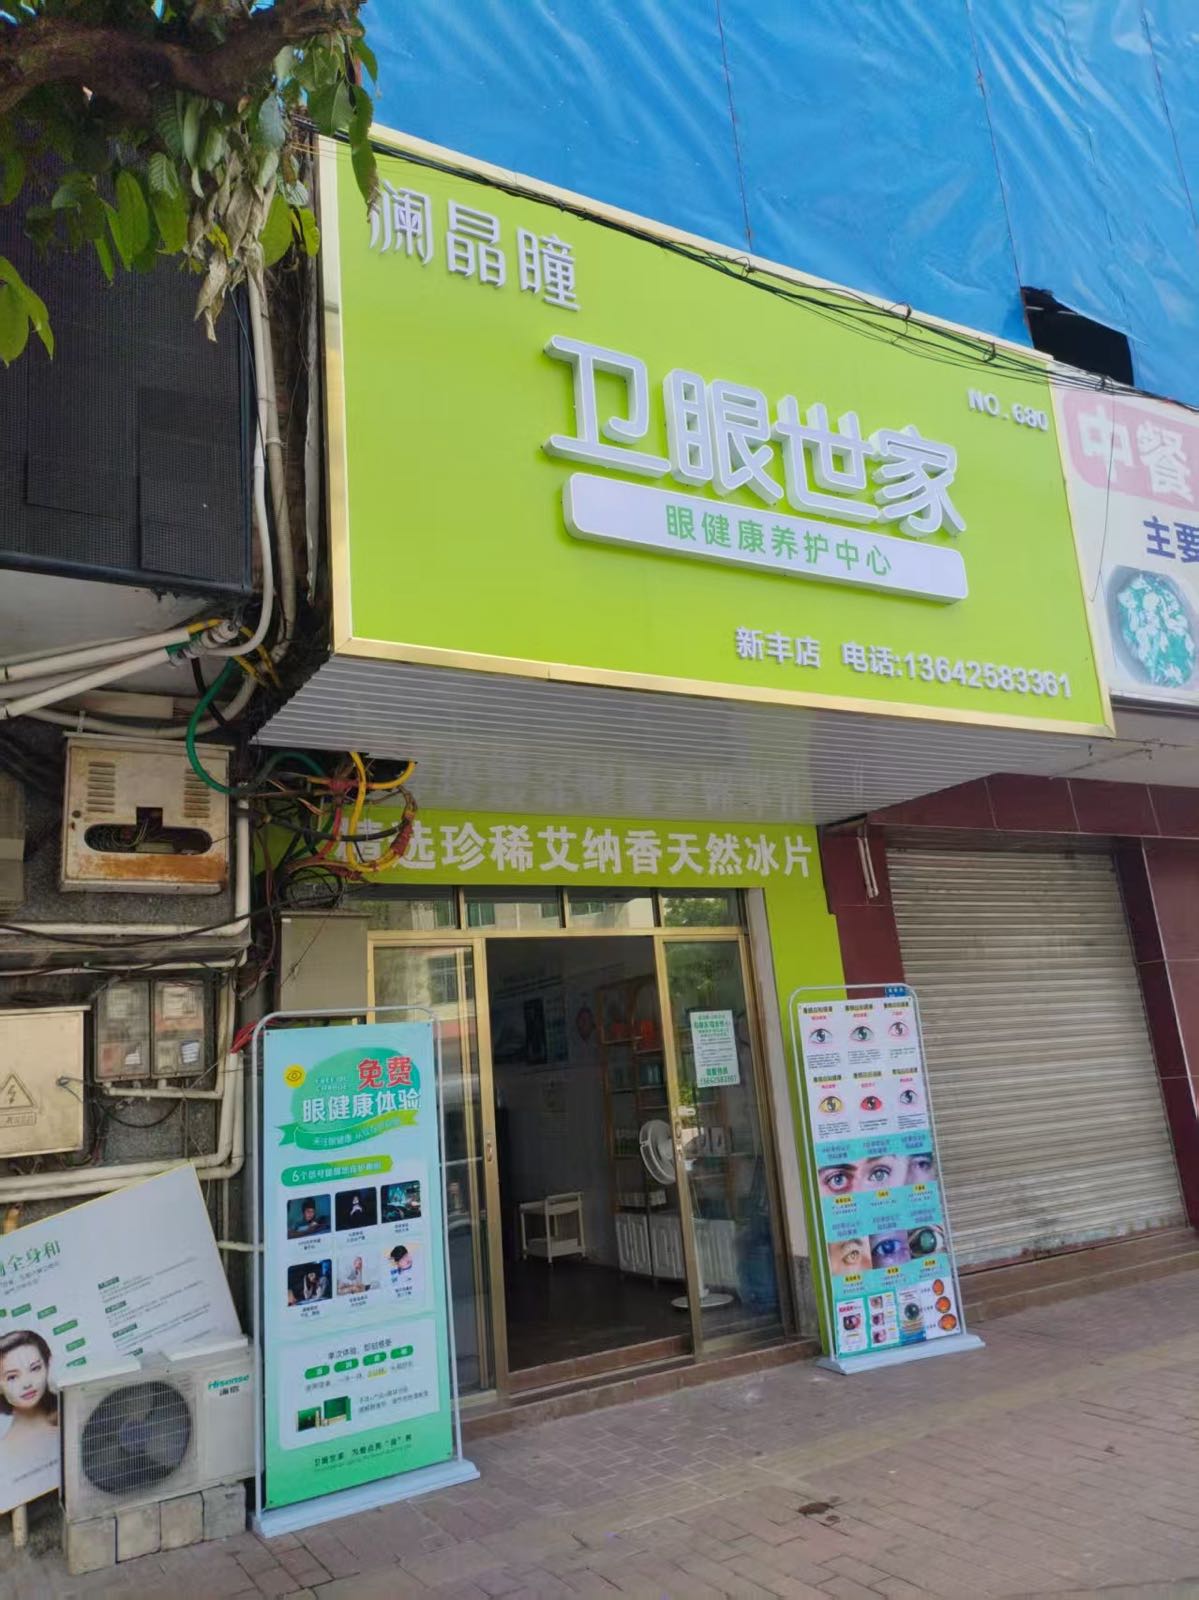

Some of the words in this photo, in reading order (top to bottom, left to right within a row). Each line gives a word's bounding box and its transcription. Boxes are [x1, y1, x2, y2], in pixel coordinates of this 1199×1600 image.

[541, 333, 966, 538] 卫眼世家
[1077, 404, 1194, 503] 中餐
[666, 504, 892, 576] 眼健康养护中心
[1143, 515, 1199, 563] 主要
[735, 626, 821, 669] 新丰店
[841, 640, 1072, 698] 电话:13642583361
[303, 1088, 421, 1123] 眼健康体验
[357, 1056, 412, 1090] 免费
